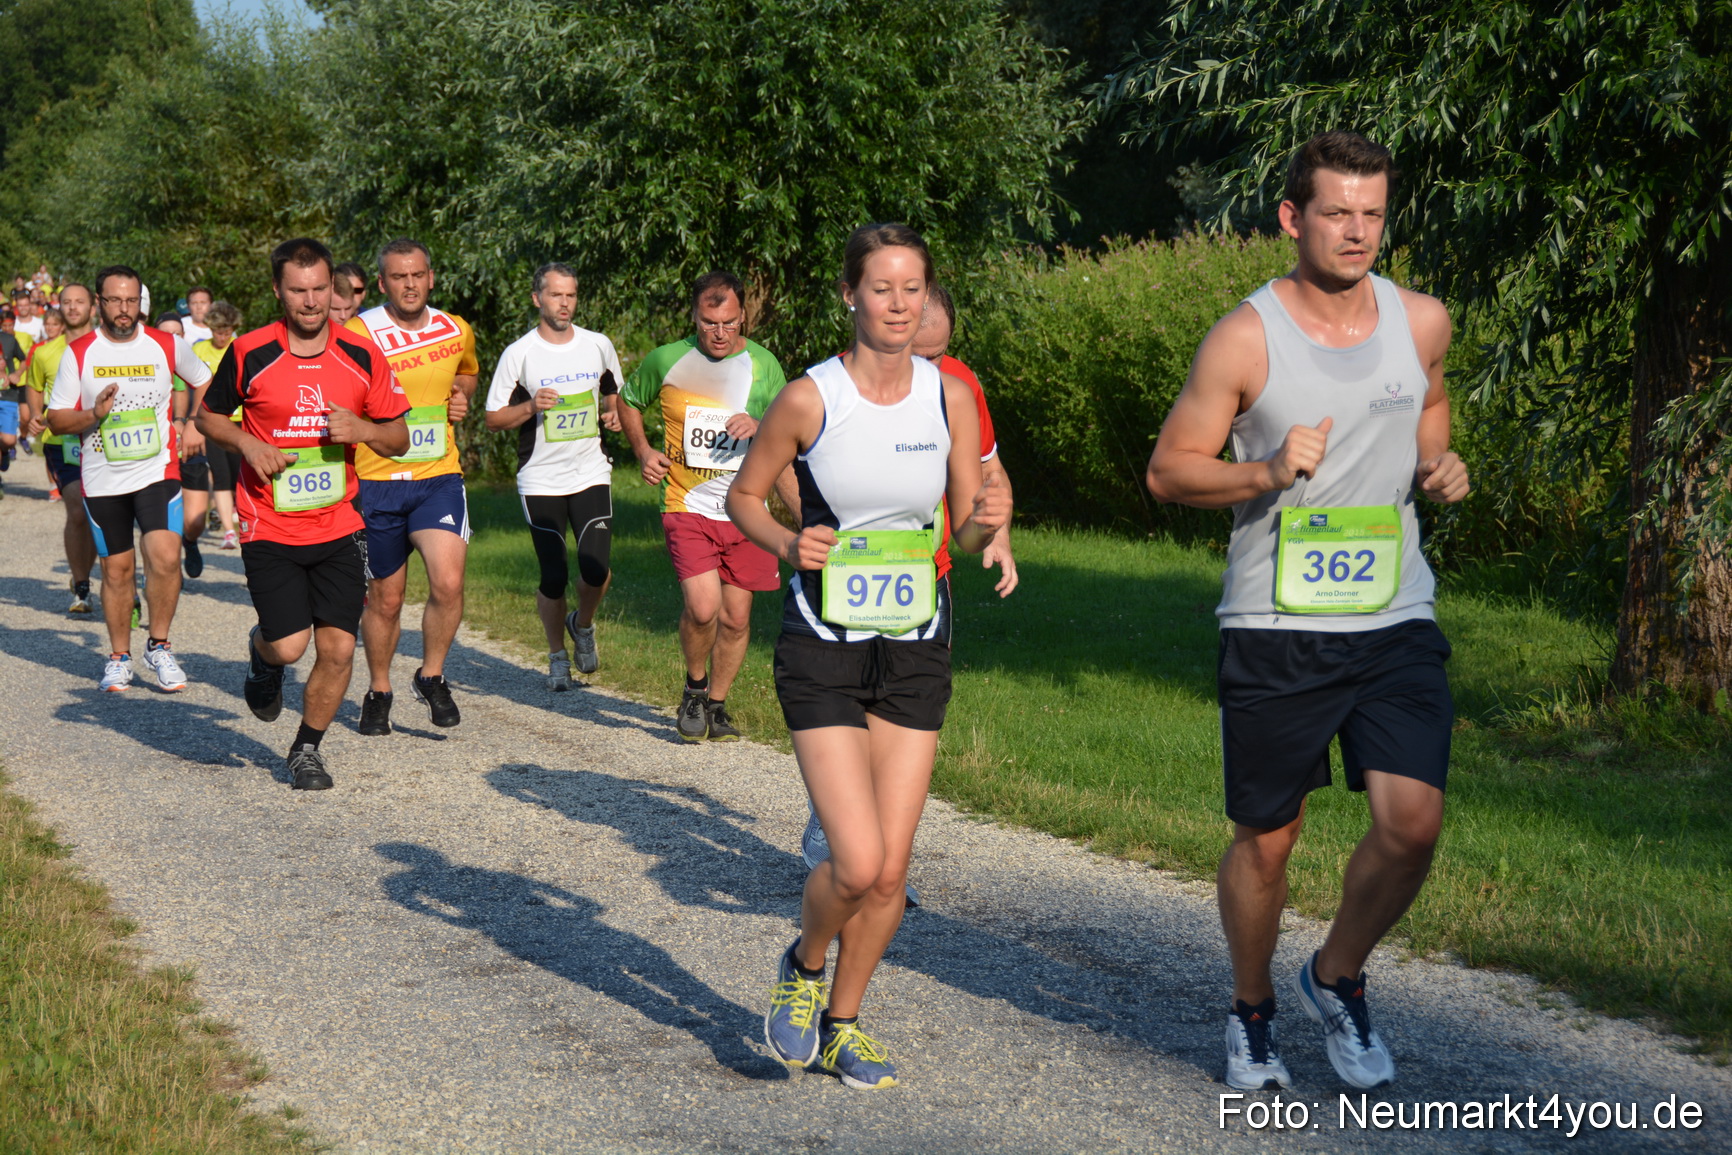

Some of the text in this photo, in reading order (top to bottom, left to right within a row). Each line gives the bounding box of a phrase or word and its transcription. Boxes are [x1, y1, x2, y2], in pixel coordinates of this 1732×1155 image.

[391, 343, 464, 373] MAX BÖGL
[97, 367, 150, 376] ONLINE
[541, 372, 599, 386] DELPHI
[556, 411, 588, 429] 277
[688, 410, 729, 422] df-spor
[109, 428, 154, 448] 1017
[273, 428, 328, 437] Fördertechnik
[411, 428, 436, 447] 04
[895, 442, 937, 452] Elisabeth
[288, 471, 332, 494] 968
[1299, 525, 1343, 533] firmenlauf
[1343, 529, 1365, 537] 2015
[841, 548, 882, 556] firmenlauf
[882, 552, 904, 560] 2015
[1302, 549, 1376, 583] 362
[846, 573, 914, 607] 976
